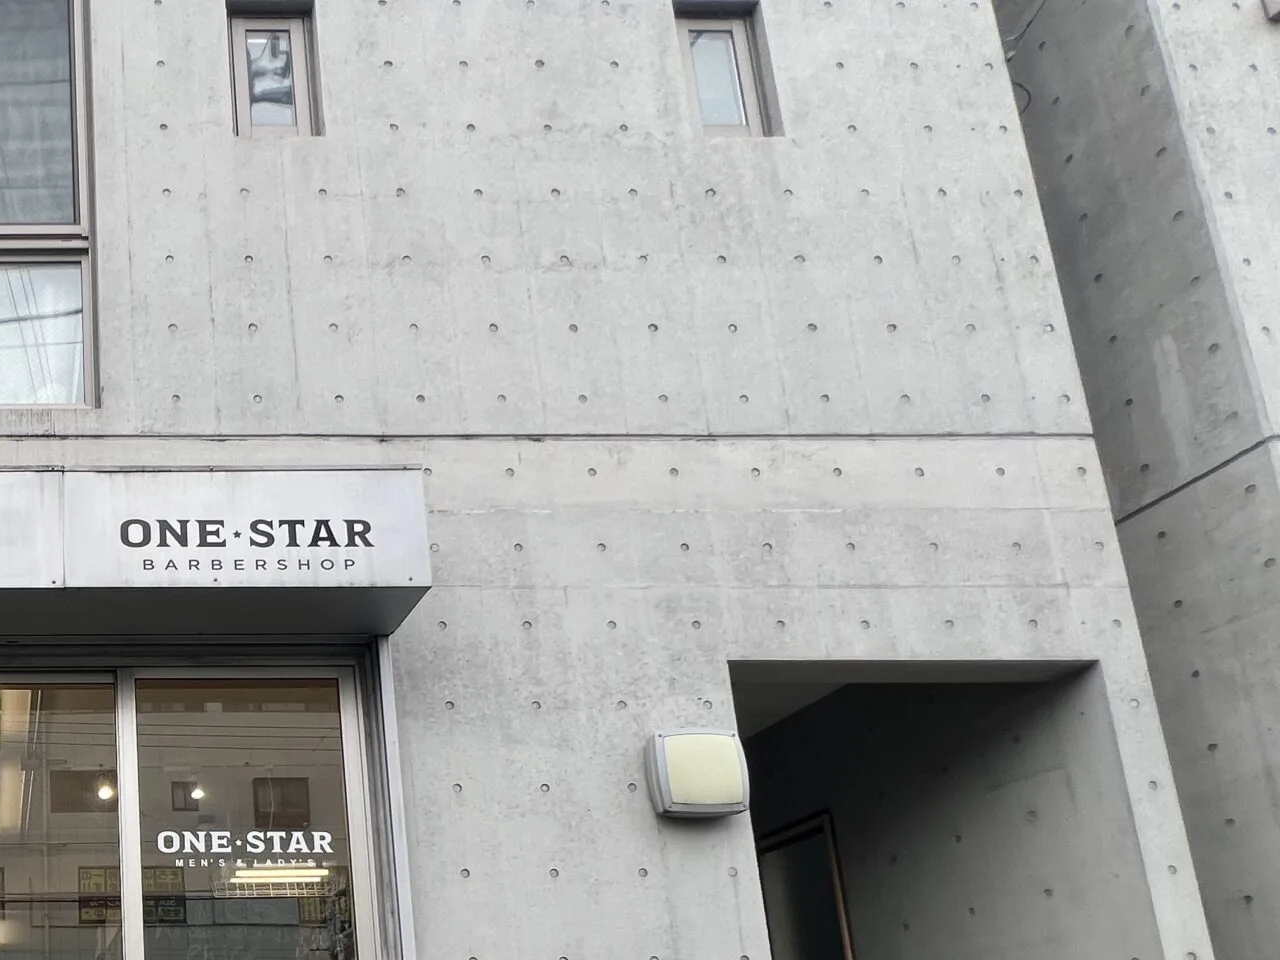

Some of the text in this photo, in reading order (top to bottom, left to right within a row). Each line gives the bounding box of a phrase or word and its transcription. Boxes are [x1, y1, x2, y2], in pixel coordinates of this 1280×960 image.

[120, 518, 375, 548] ONE STAR
[142, 558, 356, 571] BARBERSHOP
[157, 830, 334, 854] ONE STAR
[175, 858, 226, 867] MEN'S
